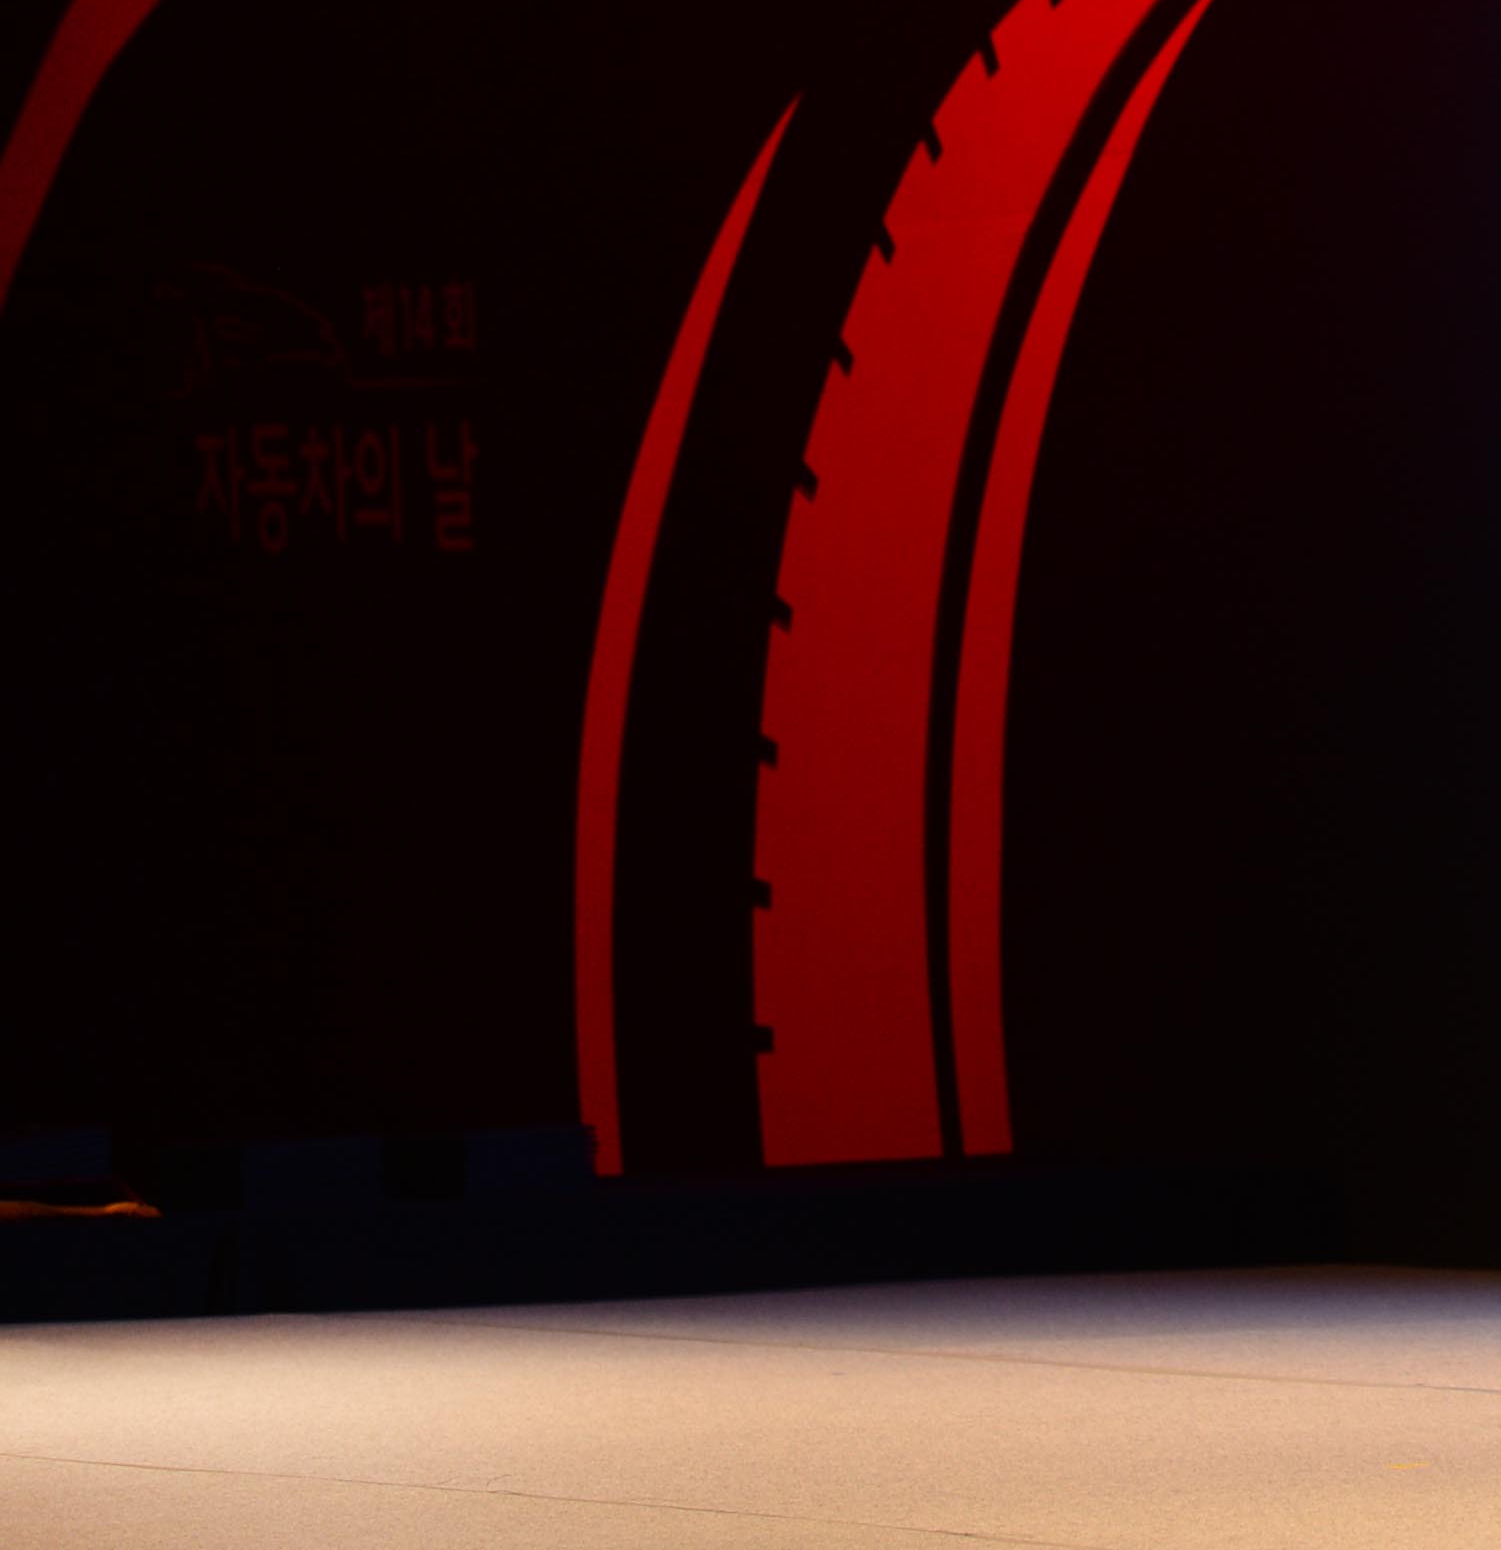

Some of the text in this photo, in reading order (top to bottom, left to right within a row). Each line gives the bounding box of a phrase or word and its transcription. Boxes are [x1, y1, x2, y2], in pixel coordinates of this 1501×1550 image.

[362, 280, 477, 353] 제14회
[196, 421, 479, 553] 자동차의 날
